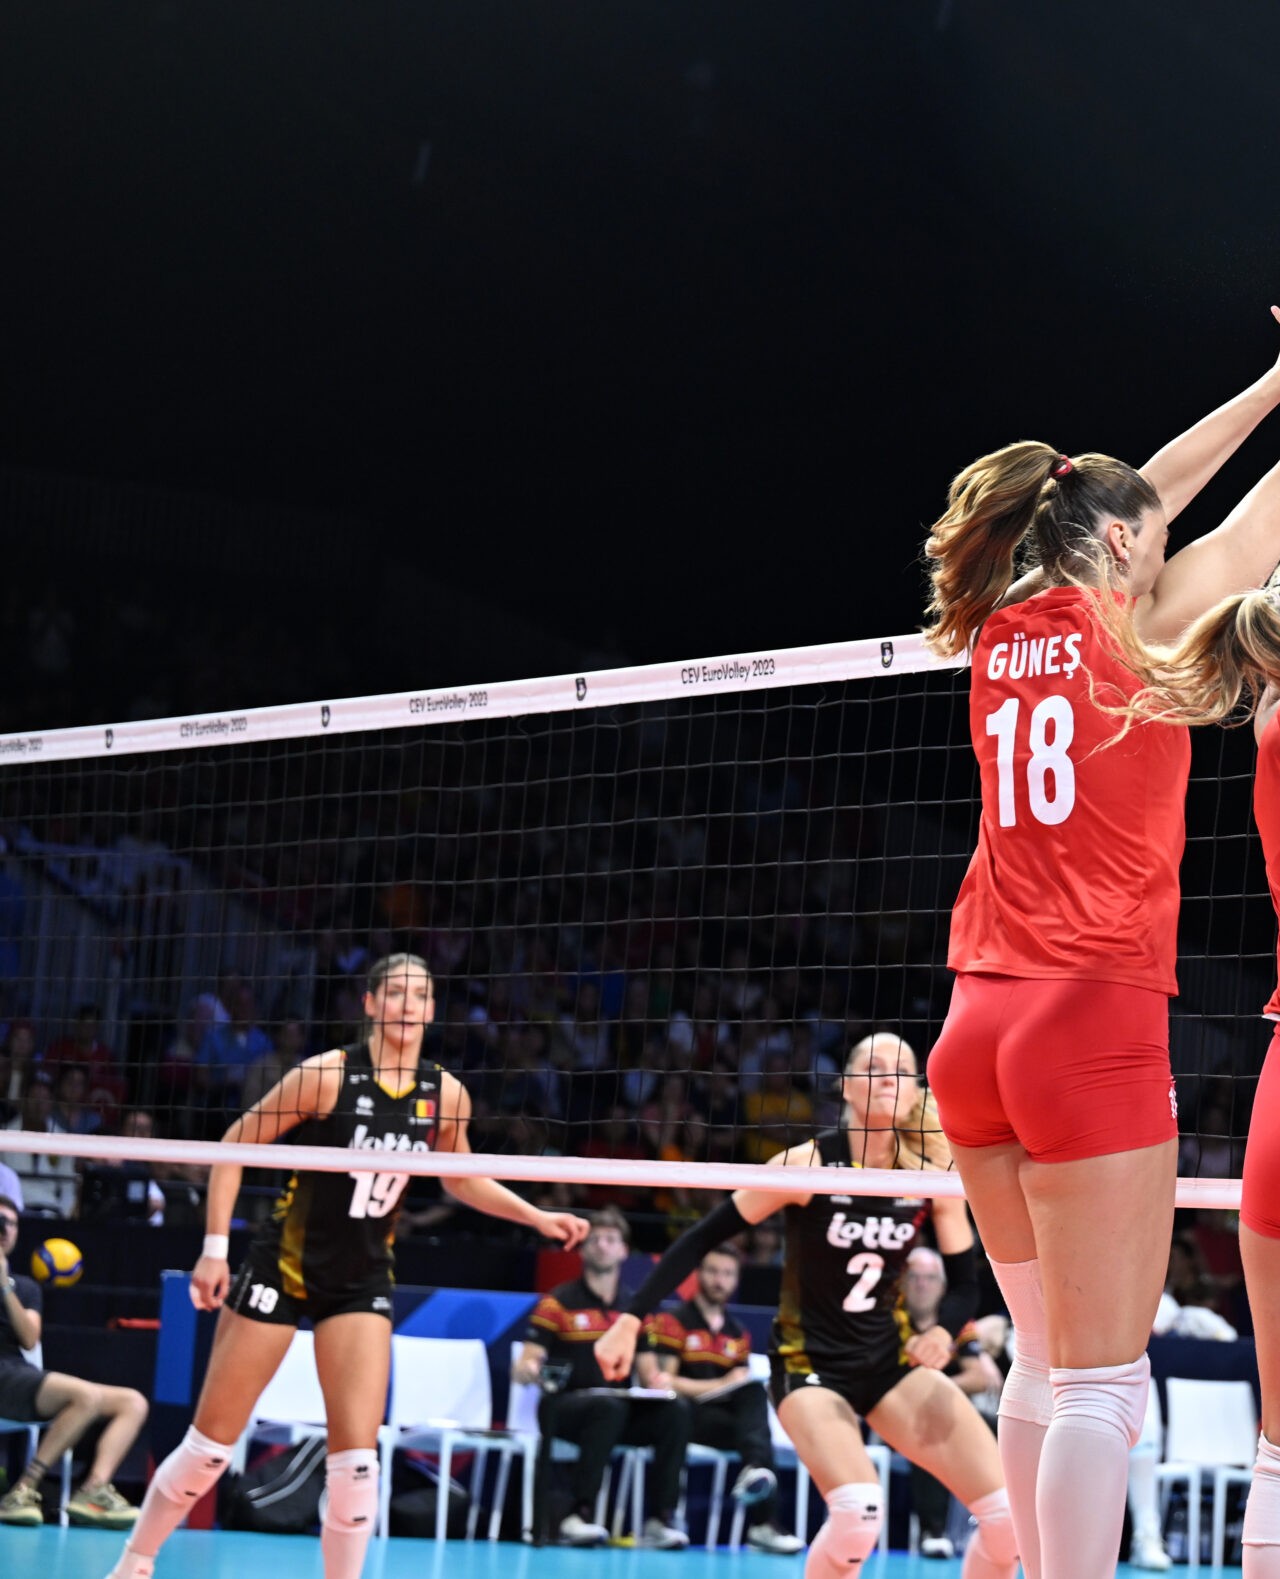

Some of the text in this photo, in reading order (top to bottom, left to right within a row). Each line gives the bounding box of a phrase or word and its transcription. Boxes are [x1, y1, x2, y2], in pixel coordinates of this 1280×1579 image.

[681, 658, 775, 684] CEV EuroVolley 2023
[986, 632, 1082, 680] GÜNEŞ
[986, 695, 1076, 828] 18
[349, 1171, 410, 1219] 19
[248, 1283, 279, 1314] 19
[842, 1252, 884, 1313] 2
